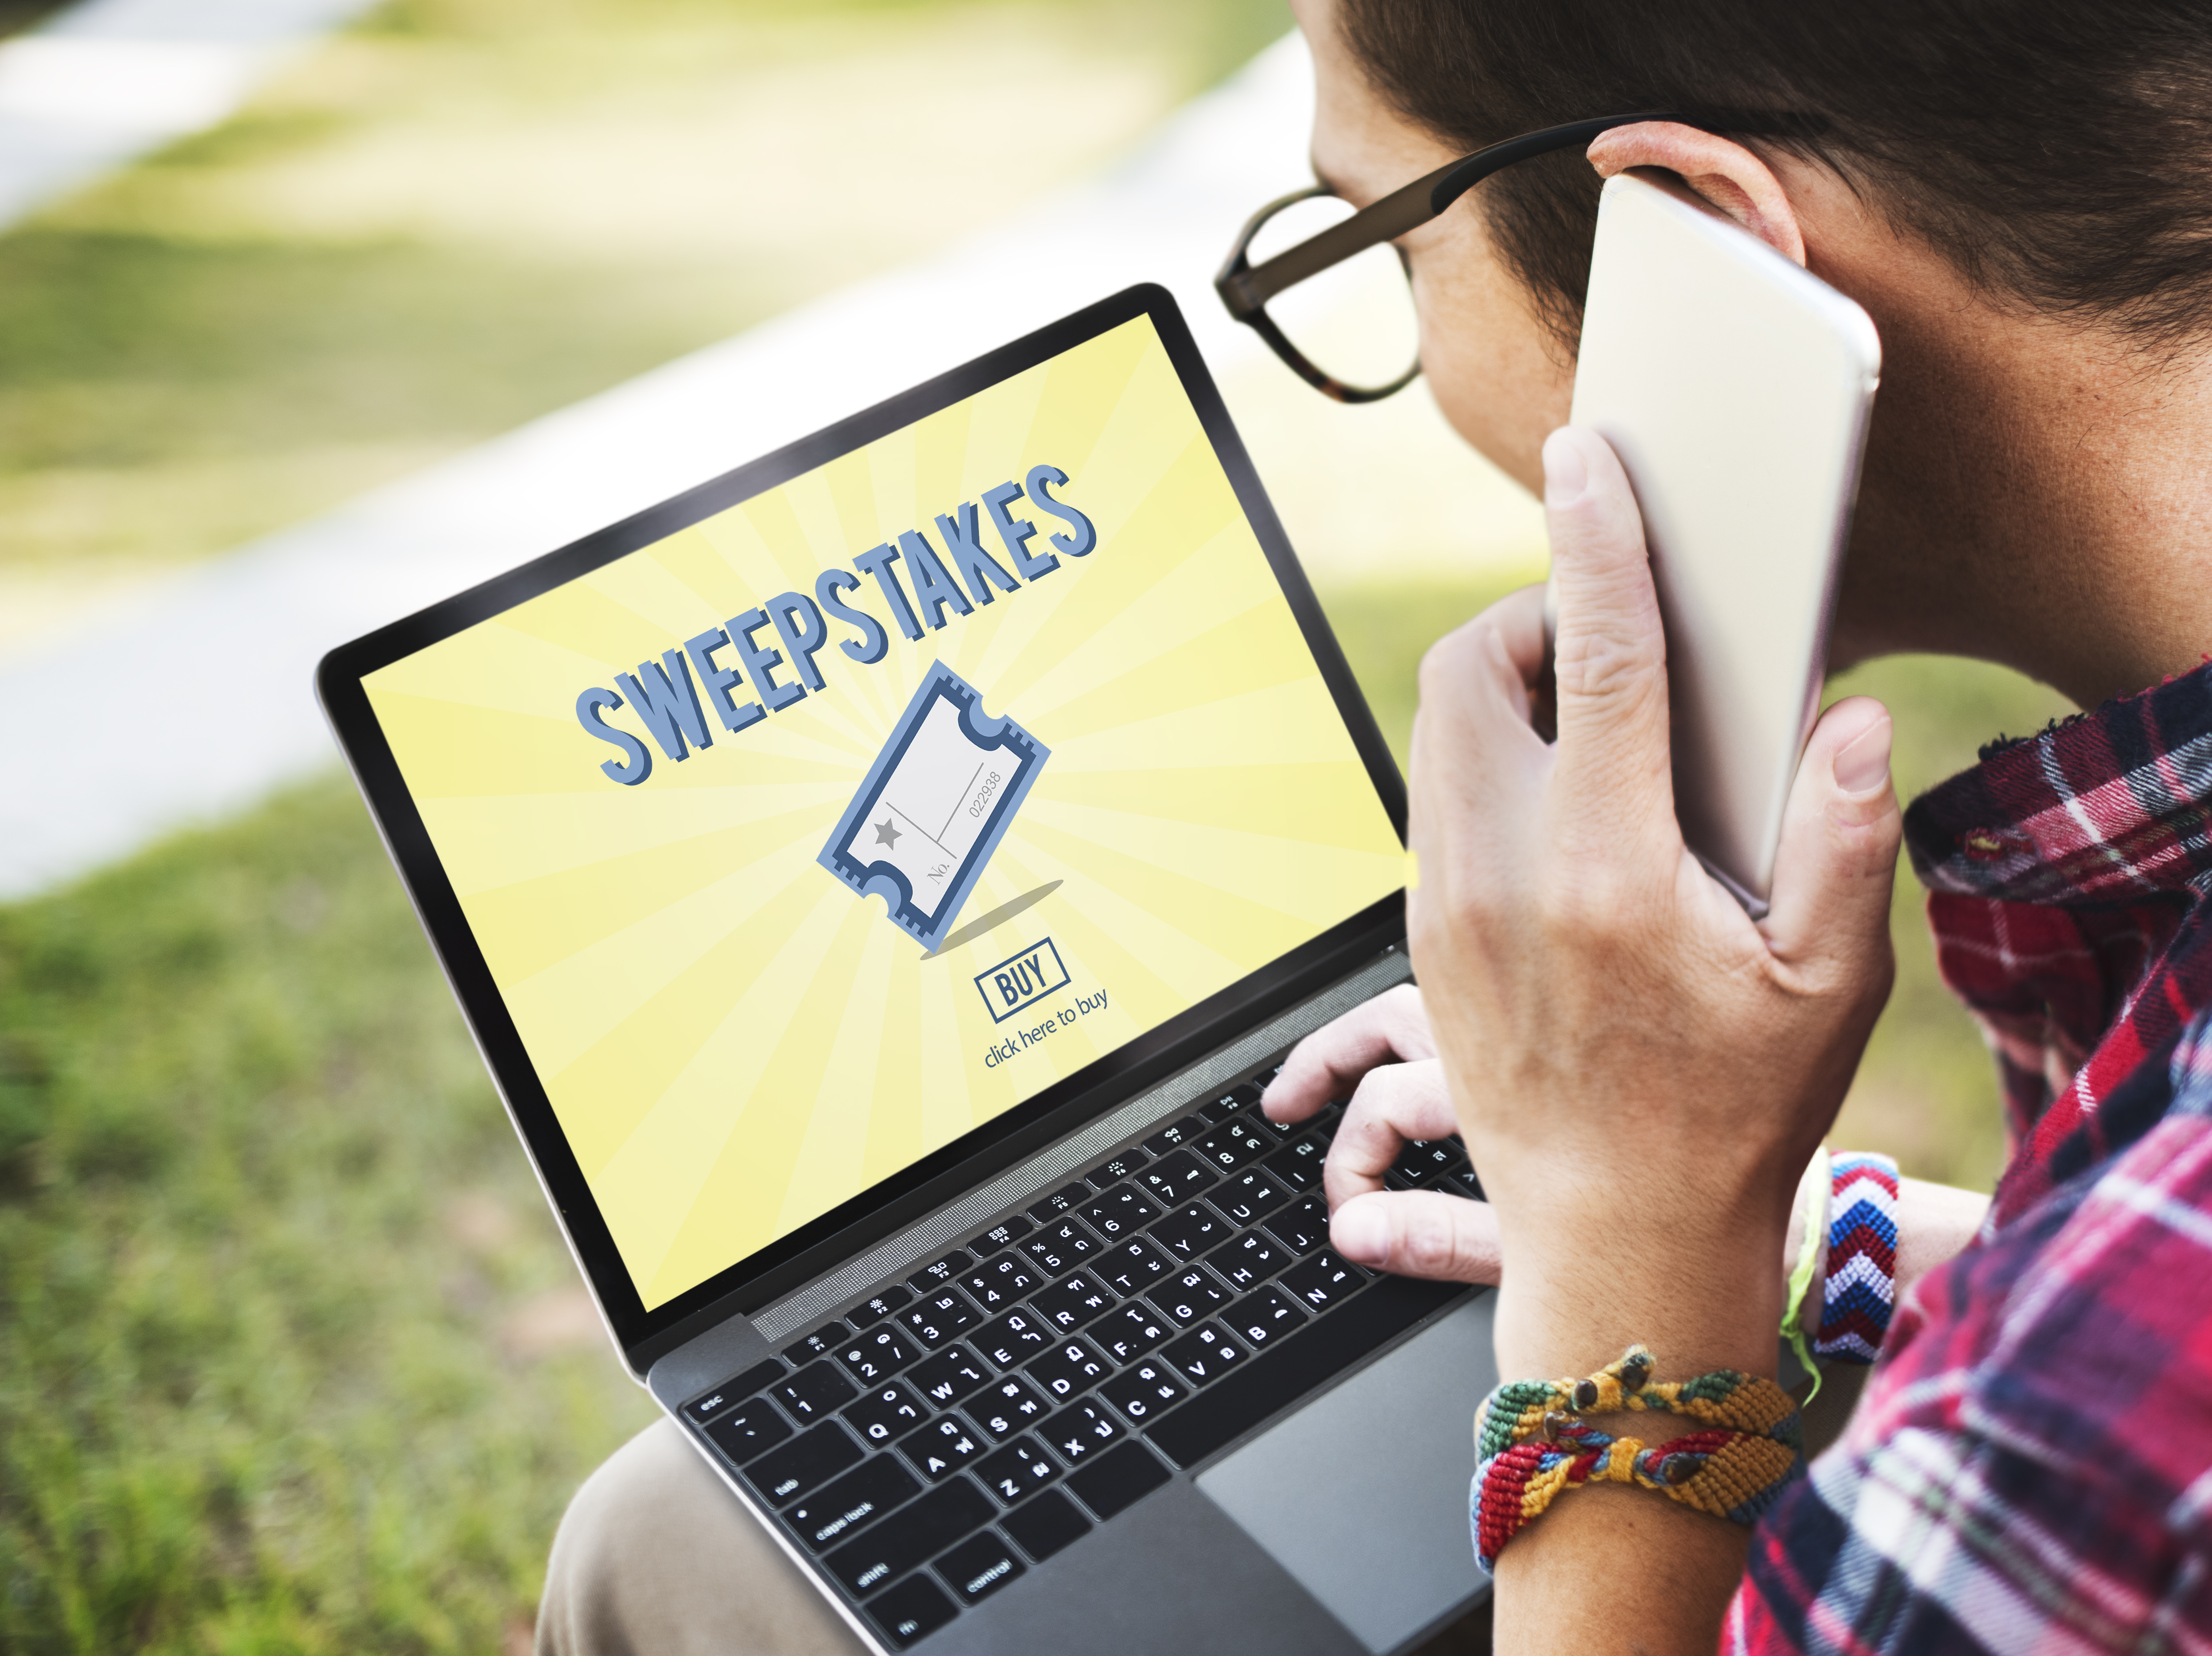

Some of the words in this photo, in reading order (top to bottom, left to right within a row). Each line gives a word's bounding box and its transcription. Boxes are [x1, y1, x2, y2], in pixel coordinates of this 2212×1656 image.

[576, 464, 1097, 786] SWEEPSTAKES
[969, 771, 1001, 818] 022938
[927, 863, 950, 886] No.
[993, 953, 1047, 1007] BUY
[985, 1037, 1021, 1068] click
[1018, 1019, 1057, 1049] here
[1057, 1008, 1076, 1026] to
[1075, 988, 1107, 1016] buy
[1246, 1139, 1261, 1149] ค
[1219, 1153, 1234, 1163] 8
[1405, 1169, 1421, 1177] L
[1161, 1185, 1174, 1197] 7
[1233, 1205, 1250, 1217] U
[1105, 1220, 1120, 1231] 6
[1075, 1240, 1089, 1250] ถ
[1175, 1239, 1190, 1251] Y
[1296, 1234, 1308, 1246] J
[1032, 1243, 1046, 1253] %
[1129, 1244, 1142, 1256] ธ
[1045, 1255, 1060, 1267] 5
[1116, 1275, 1131, 1287] T
[1233, 1268, 1252, 1283] H
[973, 1279, 984, 1287] $
[988, 1290, 1000, 1302] 4
[1085, 1295, 1102, 1307] พ
[1308, 1288, 1327, 1303] N
[1056, 1311, 1075, 1325] R
[1176, 1305, 1192, 1318] G
[924, 1326, 939, 1339] 3
[1248, 1326, 1266, 1341] B
[848, 1350, 861, 1361] @
[1114, 1341, 1127, 1356] F
[994, 1349, 1012, 1363] E
[861, 1363, 878, 1377] 2
[1084, 1363, 1100, 1375] ก
[1188, 1361, 1205, 1375] V
[931, 1382, 953, 1399] W
[1052, 1379, 1070, 1394] D
[701, 1396, 723, 1411] esc
[799, 1401, 812, 1412] 1
[1128, 1401, 1146, 1415] C
[869, 1423, 889, 1438] Q
[990, 1417, 1008, 1432] S
[1064, 1438, 1085, 1456] X
[928, 1457, 946, 1473] A
[775, 1479, 799, 1496] tab
[1000, 1479, 1019, 1497] Z
[816, 1517, 848, 1540] caps
[844, 1502, 874, 1523] lock
[858, 1563, 890, 1587] shift
